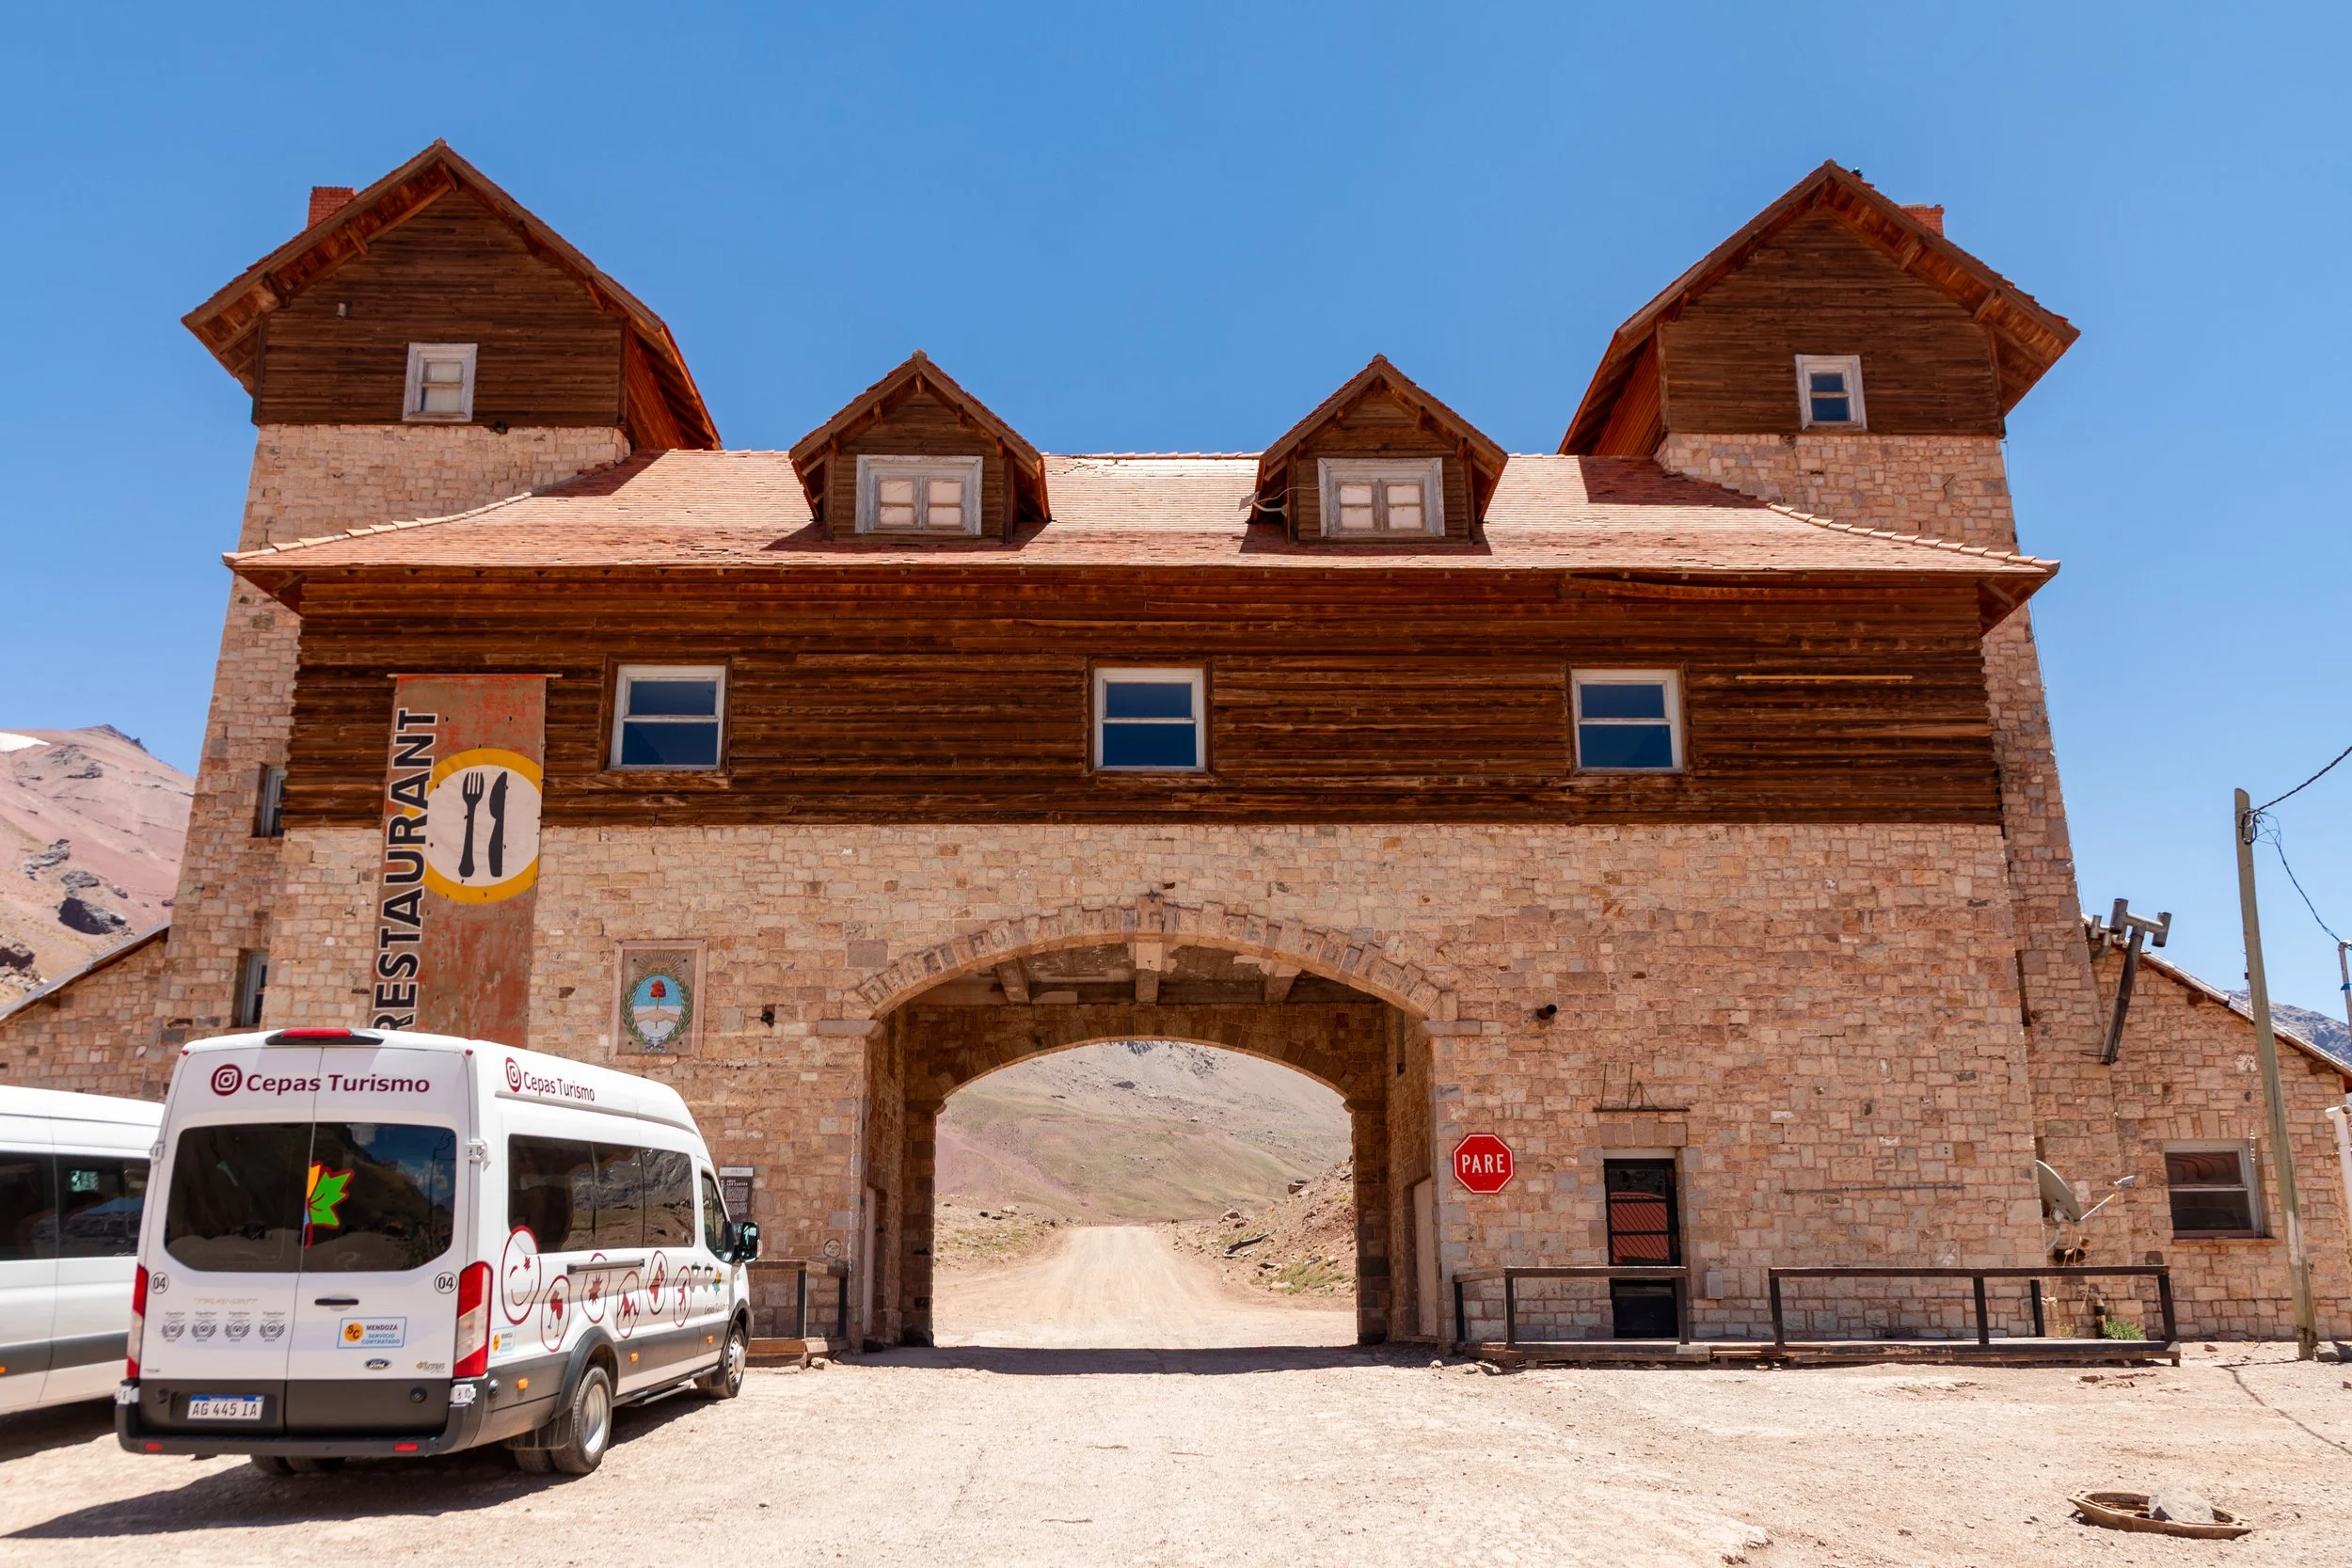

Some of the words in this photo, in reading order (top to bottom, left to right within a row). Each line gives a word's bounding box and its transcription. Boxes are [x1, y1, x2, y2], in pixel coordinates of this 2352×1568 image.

[373, 708, 437, 1031] RESTAURANT
[246, 1074, 321, 1095] Cepas
[328, 1074, 430, 1093] Turismo
[523, 1071, 556, 1096] Cepas
[557, 1078, 595, 1101] Turismo
[1461, 1153, 1505, 1174] PARE
[152, 1276, 167, 1290] 04
[437, 1276, 453, 1290] 04
[192, 1402, 210, 1416] AG
[213, 1402, 237, 1416] 445
[242, 1403, 257, 1417] IA
